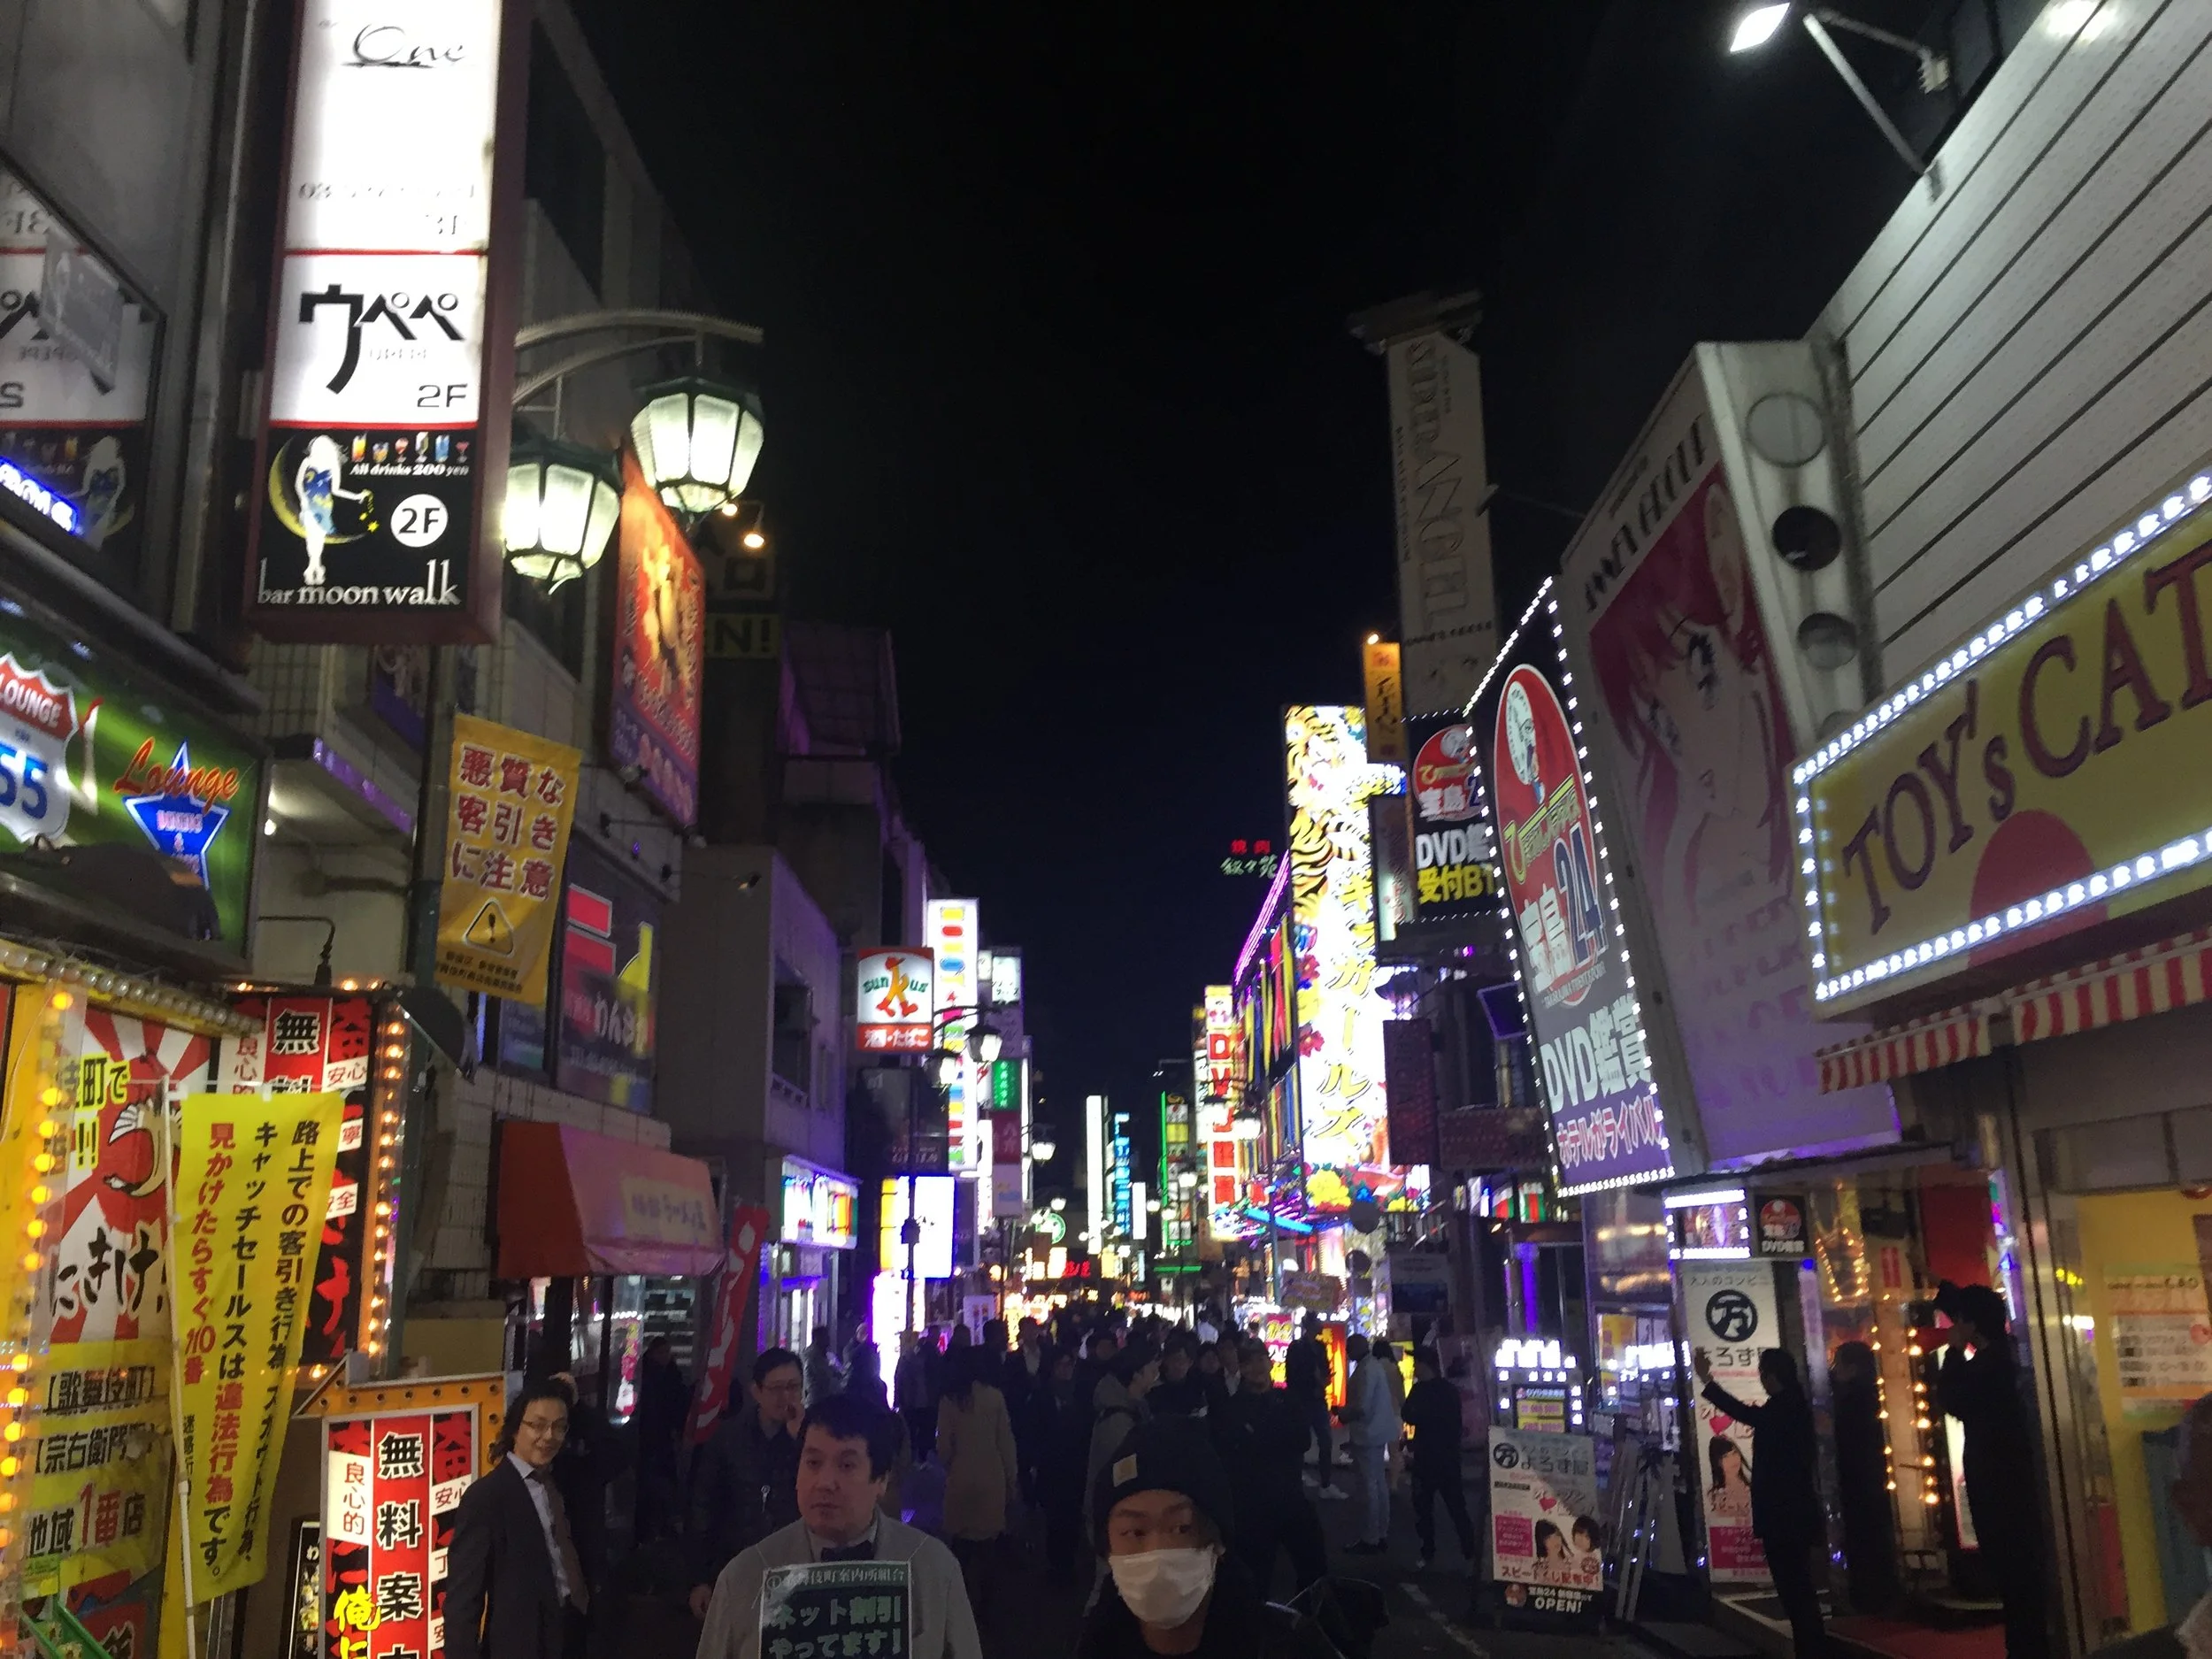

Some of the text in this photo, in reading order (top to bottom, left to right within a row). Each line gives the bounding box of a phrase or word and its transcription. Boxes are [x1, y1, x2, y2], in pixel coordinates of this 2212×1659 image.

[299, 284, 466, 395] ウペペ
[417, 382, 468, 408] 2F
[349, 464, 470, 477] All drinks 200 yen
[399, 507, 440, 534] 2F
[257, 557, 462, 606] bar moon walk
[113, 736, 240, 815] Lounge
[459, 743, 566, 814] 悪質な
[1842, 678, 2016, 936] TOY's
[457, 794, 558, 860] 客引き
[452, 841, 557, 909] に注意
[327, 1064, 367, 1088] 安心
[1540, 992, 1651, 1114] DVD鑑賞
[1556, 1094, 1663, 1170] ホテルがライバル
[267, 1120, 320, 1371] 路上での客引き行為
[343, 1462, 365, 1535] 良心的
[375, 1431, 450, 1659] 無料案
[771, 1595, 902, 1631] ネット割引
[1534, 1596, 1583, 1614] OPEN!
[769, 1627, 902, 1659] やってます!
